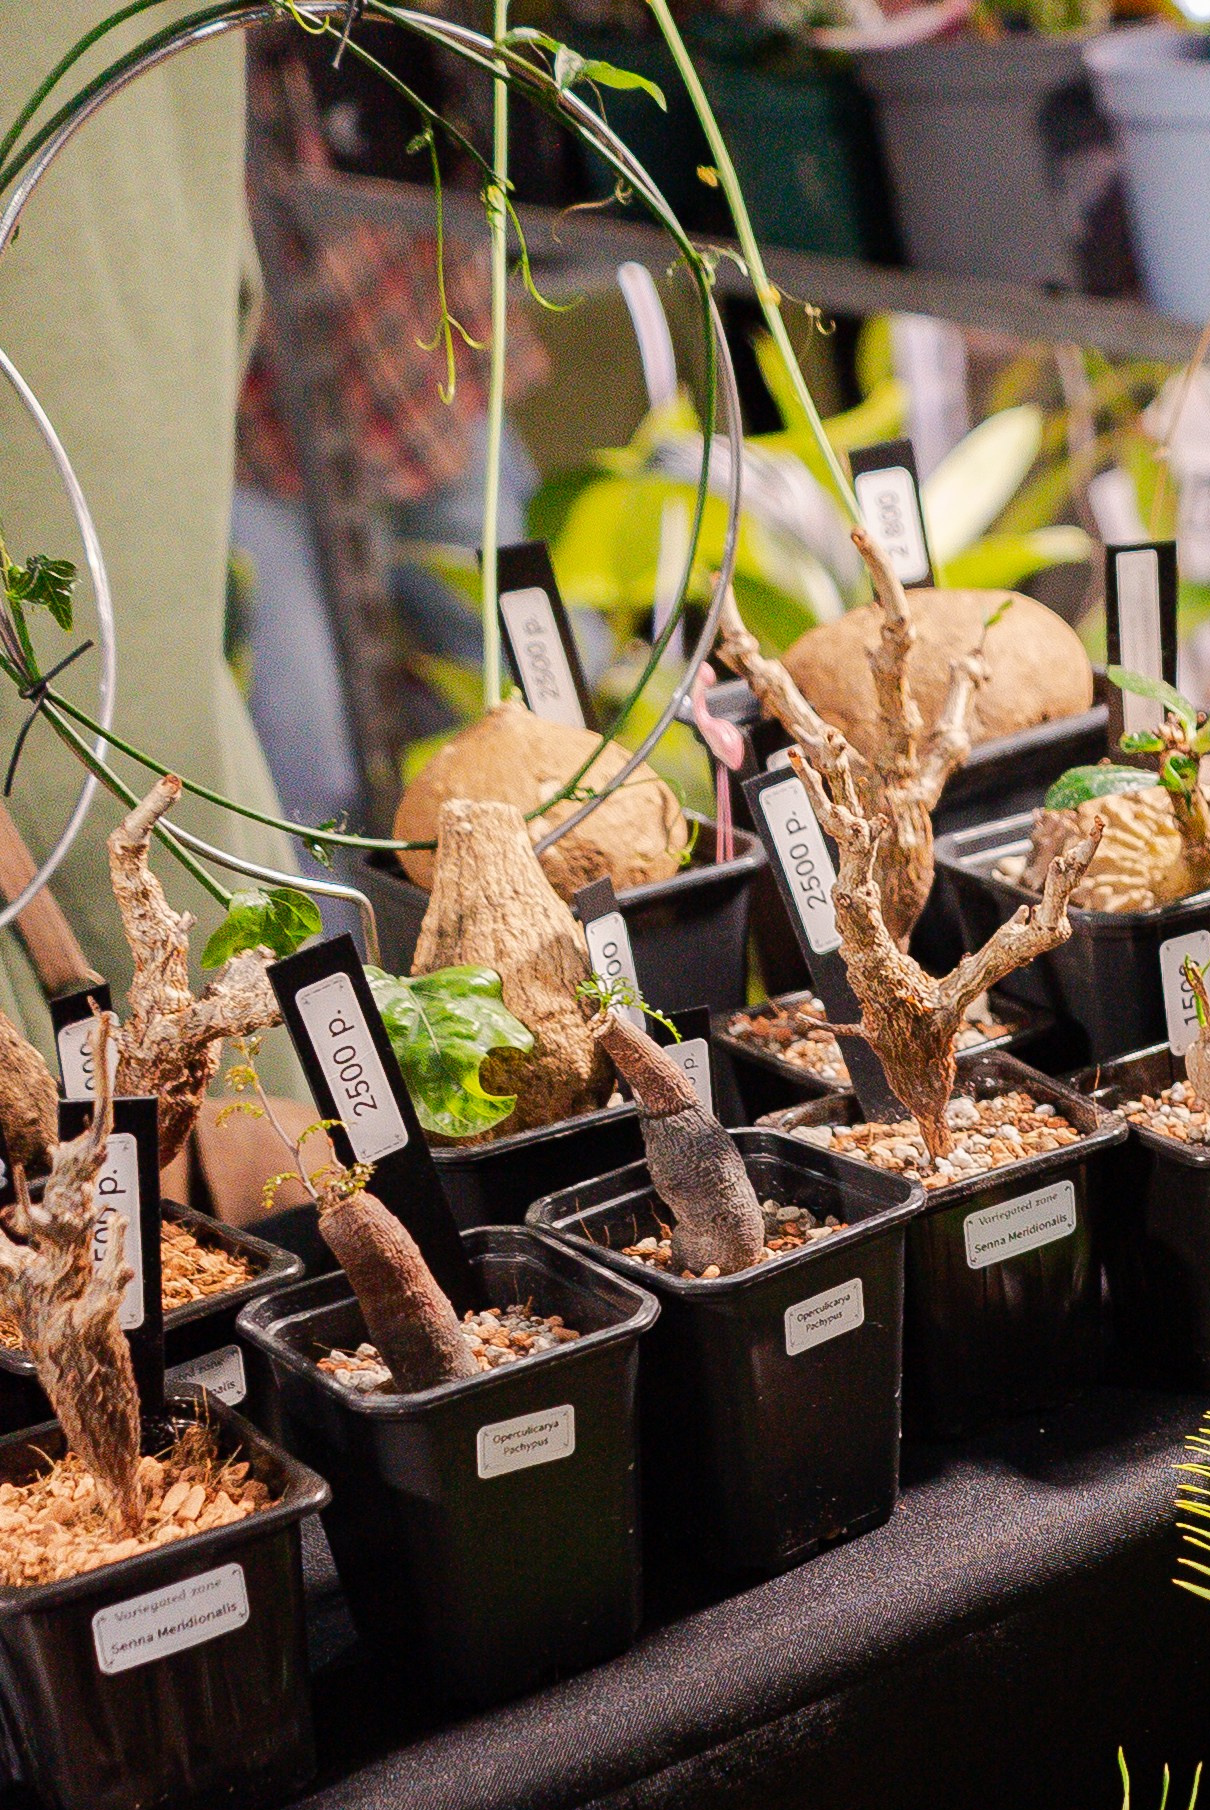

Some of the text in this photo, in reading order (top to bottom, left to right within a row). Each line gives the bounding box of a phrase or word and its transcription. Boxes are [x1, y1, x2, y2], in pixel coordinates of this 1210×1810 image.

[789, 843, 828, 910] 2500
[332, 1044, 379, 1118] 2500
[978, 1192, 1059, 1227] Variegated zone
[973, 1212, 1068, 1256] Senna Meridionalis
[797, 1293, 852, 1324] Operculicarya
[805, 1310, 844, 1334] Pachypus
[491, 1419, 560, 1447] Operculicarya
[503, 1437, 550, 1457] Pachypus
[115, 1577, 224, 1623] Variegated zone
[111, 1601, 239, 1657] Senna Meridionalis
